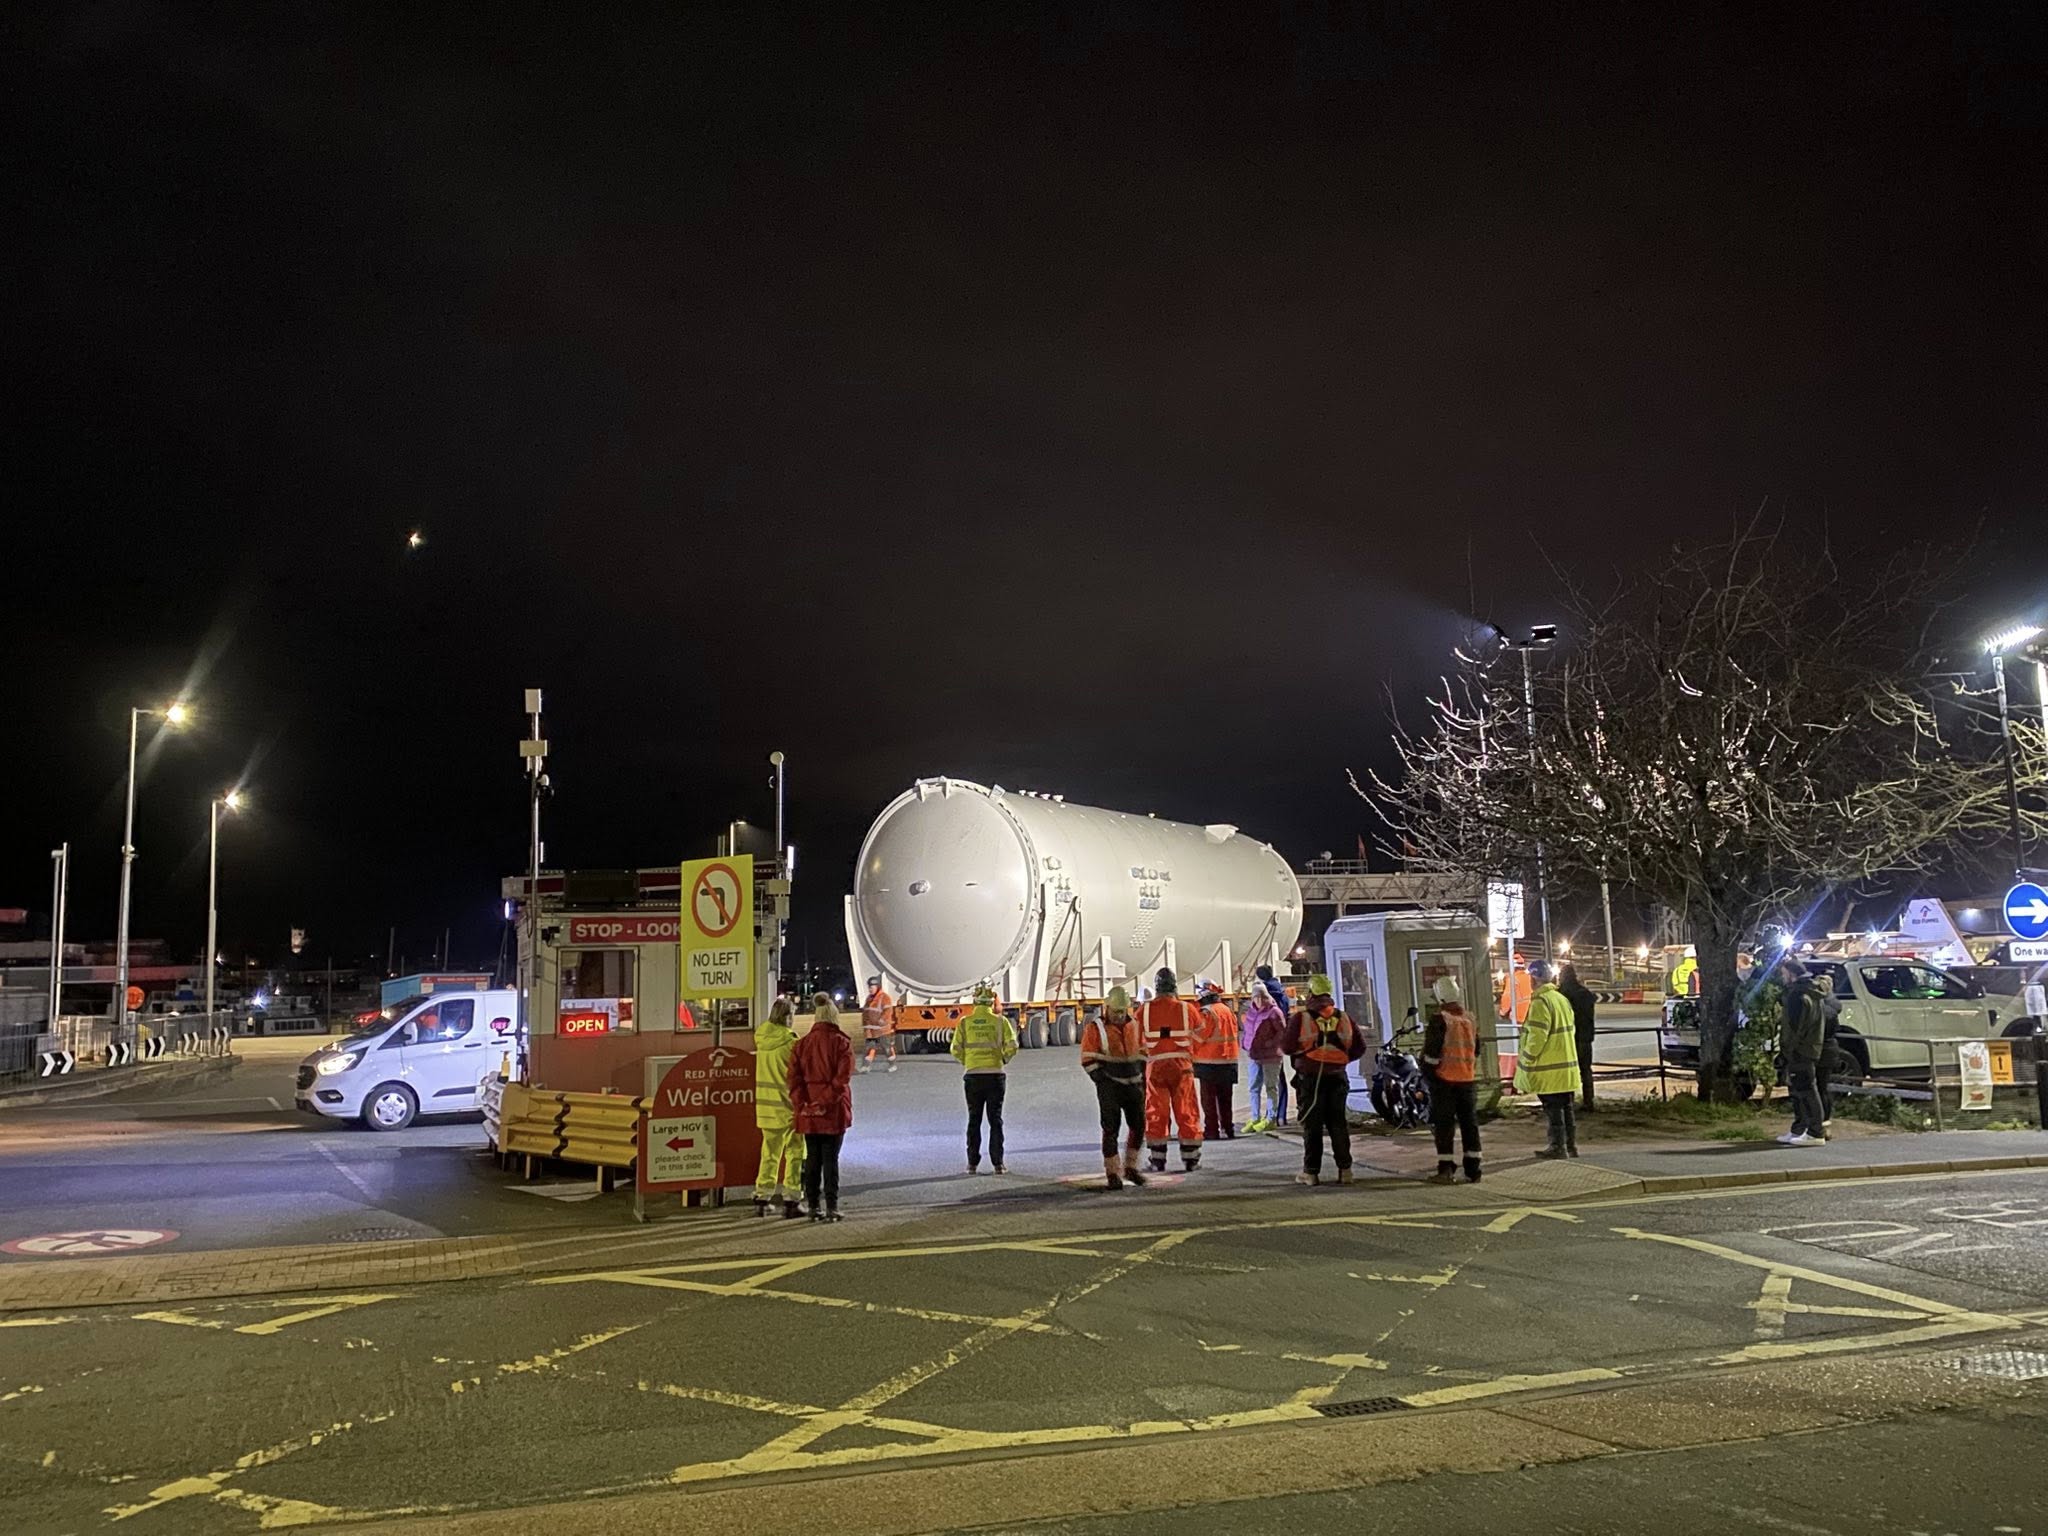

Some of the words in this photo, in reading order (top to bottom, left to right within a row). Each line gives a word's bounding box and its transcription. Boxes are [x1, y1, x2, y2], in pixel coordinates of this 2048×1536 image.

[575, 923, 623, 937] STOP
[2014, 946, 2033, 957] One
[2035, 947, 2048, 956] wa
[693, 952, 710, 968] NO
[713, 951, 741, 966] LEFT
[700, 970, 733, 986] TURN
[565, 1018, 605, 1033] OPEN
[684, 1069, 706, 1080] RED
[709, 1068, 750, 1079] FUNNEL
[667, 1086, 754, 1107] Welcom
[652, 1124, 679, 1136] Large
[654, 1155, 680, 1164] please
[683, 1153, 706, 1162] check
[658, 1164, 667, 1172] in
[668, 1163, 684, 1171] this
[685, 1161, 703, 1170] side
